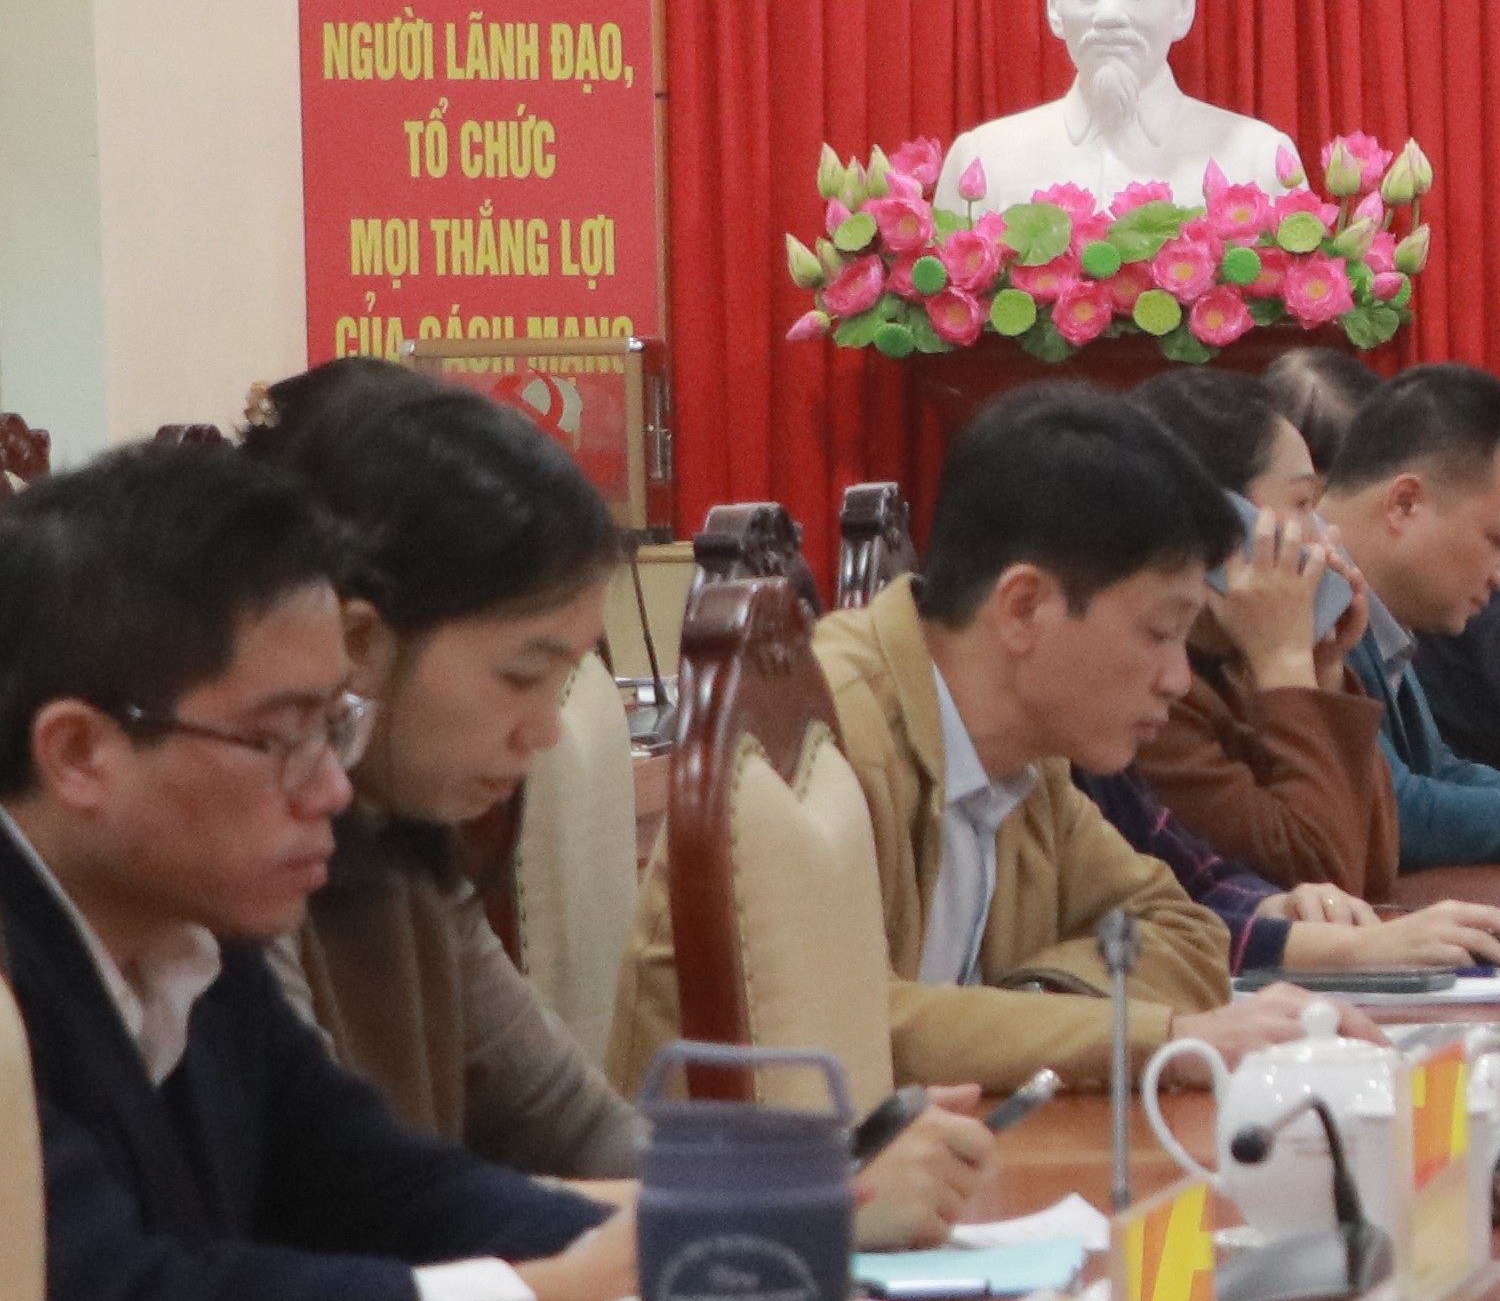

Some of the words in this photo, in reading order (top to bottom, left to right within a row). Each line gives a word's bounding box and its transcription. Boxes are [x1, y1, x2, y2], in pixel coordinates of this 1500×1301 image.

[323, 9, 433, 80] NGƯỜI
[446, 12, 539, 80] LÃNH
[550, 23, 633, 93] ĐẠO,
[404, 97, 448, 178] TỔ
[460, 104, 555, 179] CHỨC
[351, 218, 419, 288] MỌI
[430, 199, 549, 276] THẮNG
[560, 214, 615, 289] LỢI
[336, 291, 404, 361] CỦA
